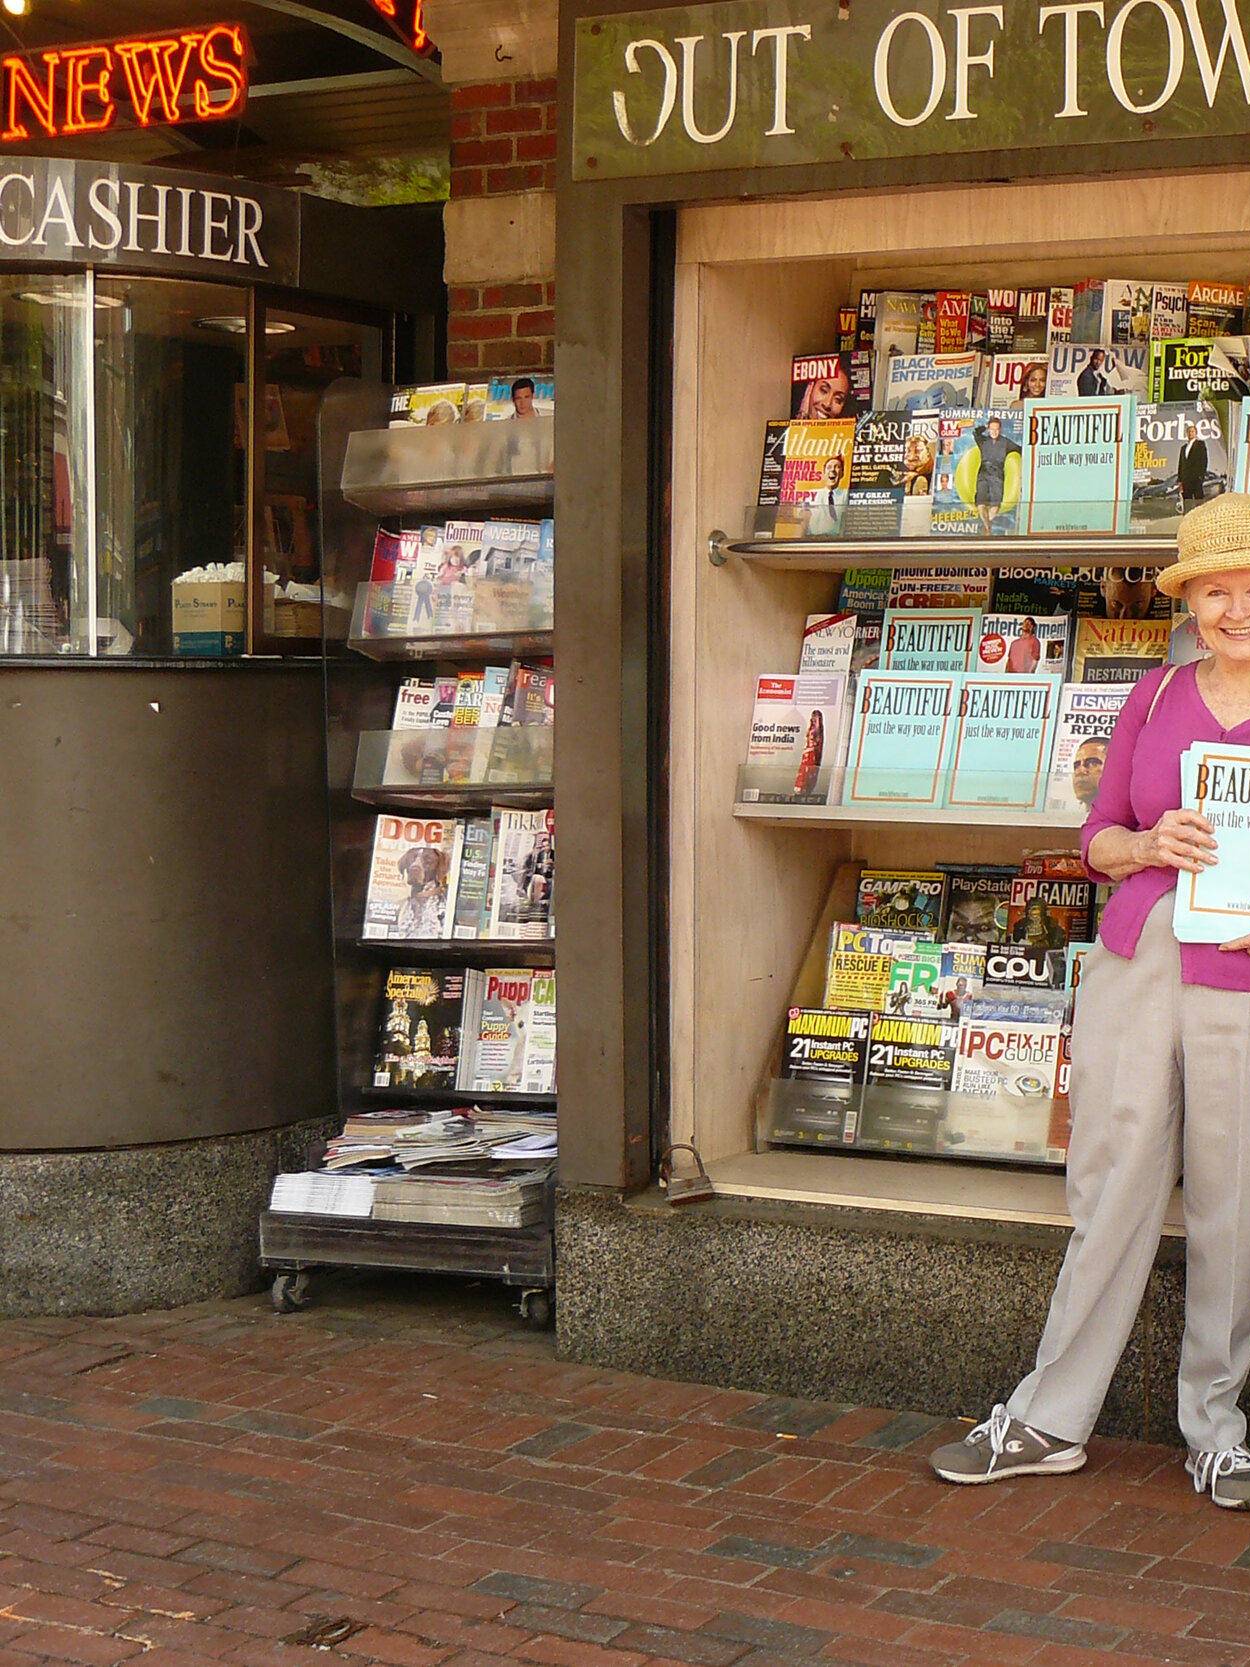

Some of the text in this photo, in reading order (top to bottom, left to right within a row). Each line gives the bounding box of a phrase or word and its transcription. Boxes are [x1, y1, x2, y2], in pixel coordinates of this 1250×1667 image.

[873, 5, 1004, 127] OF
[2, 23, 246, 141] NEWS
[0, 173, 269, 269] CASHIER
[793, 359, 839, 381] EBONY
[893, 358, 936, 371] BLACK
[891, 366, 973, 383] ENTERPRISE
[940, 410, 983, 419] SUMMER
[942, 421, 958, 430] TV
[1028, 413, 1123, 446] BEAUTIFUL
[1135, 414, 1222, 442] Forbes
[769, 425, 854, 456] Atlantic
[854, 445, 904, 454] LET THEM
[853, 453, 903, 463] EAT CASH
[785, 460, 817, 471] WHAT
[783, 471, 822, 482] MAKES
[782, 481, 796, 491] US
[780, 490, 817, 502] HAPPY
[931, 521, 978, 533] CONAN!
[900, 583, 987, 593] UN-FREEZE Your
[1034, 577, 1077, 589] MARKETS
[899, 593, 987, 608] CREDIT
[996, 592, 1029, 602] Nadal's
[995, 602, 1048, 614] Net Profits
[885, 624, 973, 652] BEAUTIFUL
[802, 657, 836, 668] billionaire
[401, 690, 430, 705] free
[759, 687, 793, 695] Economist
[860, 686, 952, 717] BEAUTIFUL
[753, 723, 800, 733] Good news
[751, 734, 795, 744] from India
[1206, 808, 1225, 827] just
[1227, 811, 1244, 828] the
[382, 818, 442, 843] DOG
[1012, 880, 1090, 906] PC GAMER
[860, 913, 923, 927] BIOSHOCK
[836, 958, 883, 972] RESCUE
[987, 957, 1050, 981] CPU
[388, 970, 431, 985] American
[482, 1021, 510, 1031] Puppy
[789, 1038, 855, 1059] 21 Instant PC
[967, 1032, 1056, 1060] PC FIX-IT
[810, 1050, 859, 1062] UPGRADES
[1004, 1049, 1054, 1063] GUIDE
[963, 1076, 997, 1085] BUSTED
